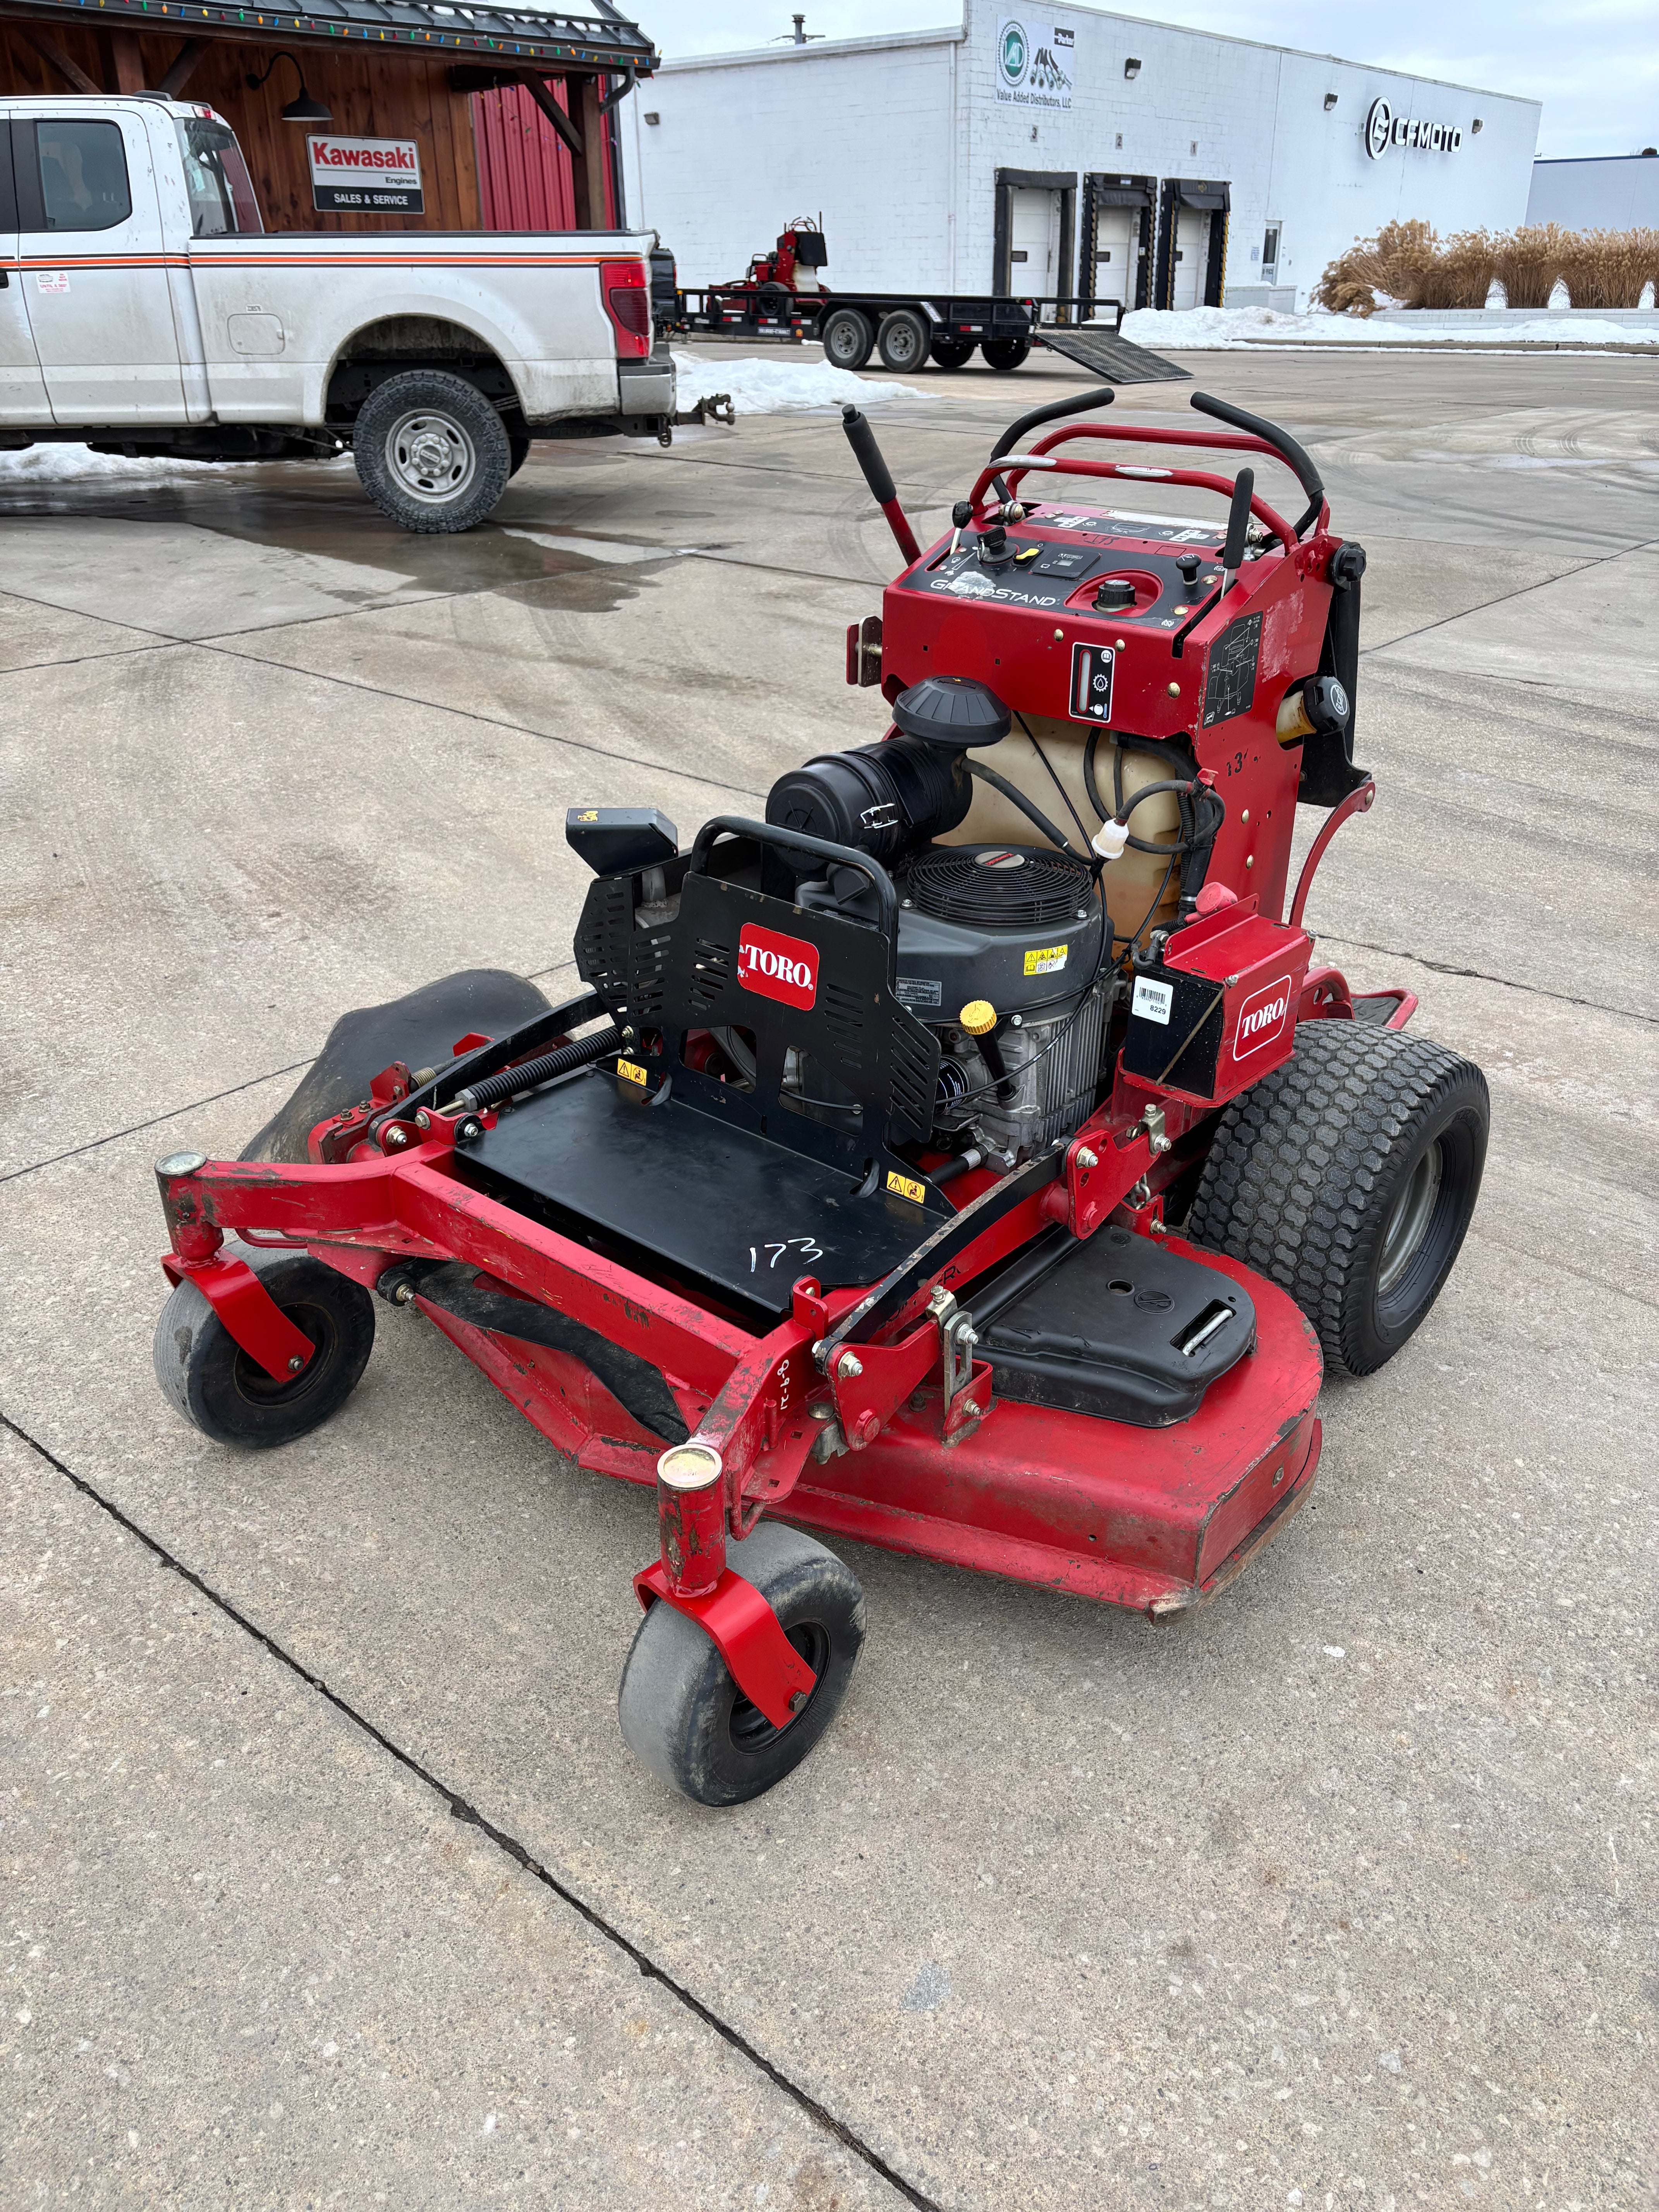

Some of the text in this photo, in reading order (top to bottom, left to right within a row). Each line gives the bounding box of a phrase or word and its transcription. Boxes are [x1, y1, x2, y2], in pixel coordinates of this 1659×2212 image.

[996, 88, 1012, 101] Value
[1013, 90, 1030, 104] Added
[1062, 96, 1072, 108] LLC
[1392, 117, 1463, 153] CFMOTO
[313, 142, 416, 169] Kawasaki
[385, 177, 417, 185] Engines
[334, 193, 409, 205] SALES & SERVICE
[745, 944, 811, 987] TORO
[1150, 1005, 1166, 1015] 8229
[1242, 997, 1284, 1039] TORO
[749, 1237, 823, 1273] 173
